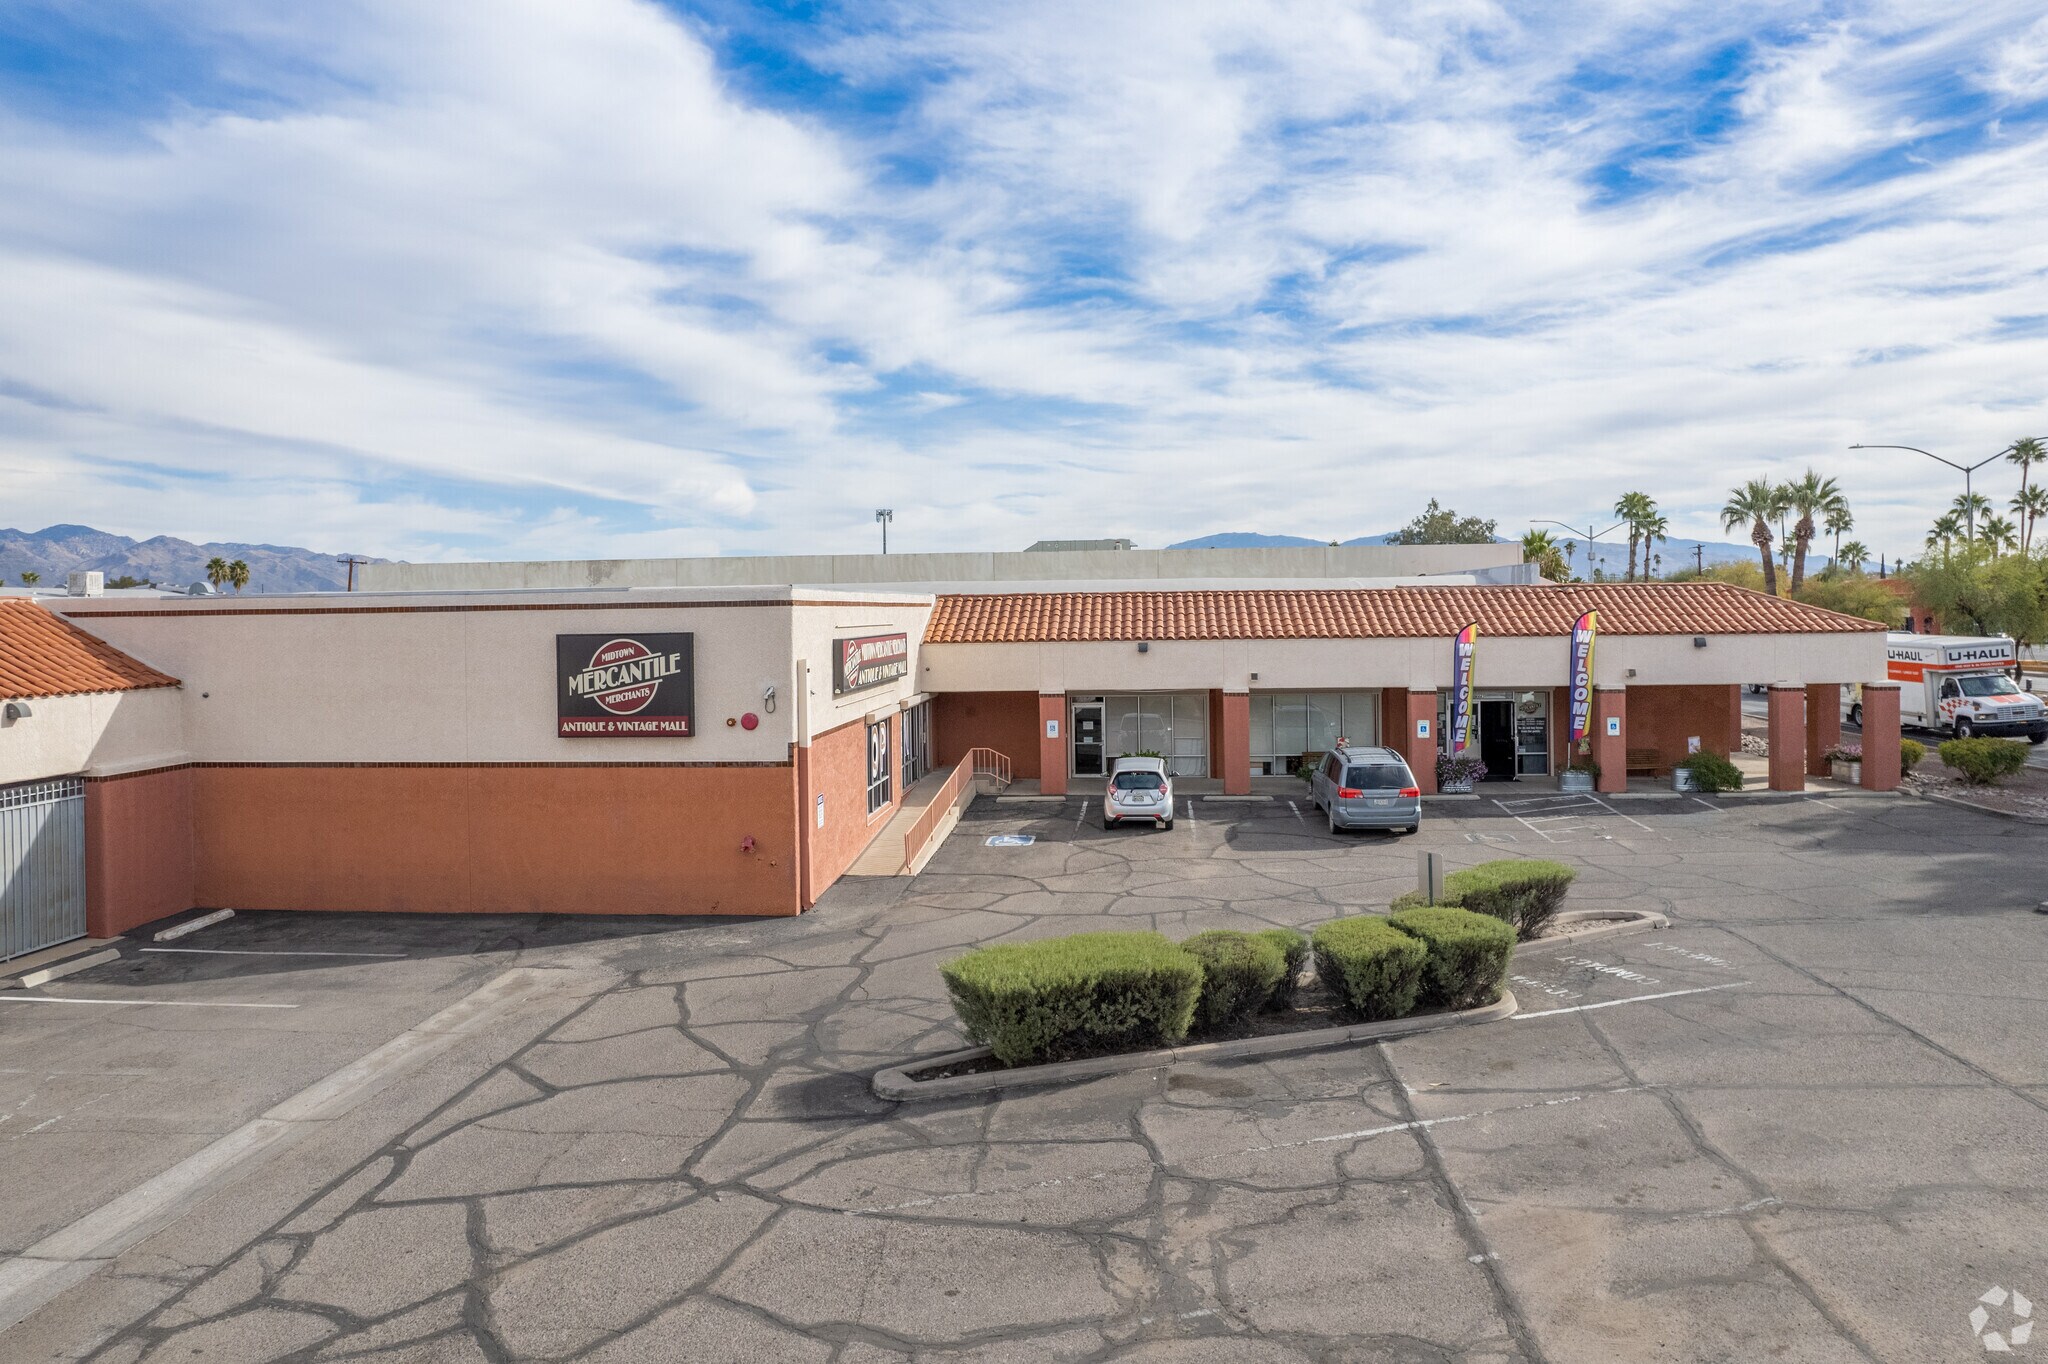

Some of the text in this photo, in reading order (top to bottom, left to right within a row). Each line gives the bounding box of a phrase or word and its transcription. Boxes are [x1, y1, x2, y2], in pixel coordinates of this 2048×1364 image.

[601, 647, 635, 662] MIDTOWN
[1948, 648, 2010, 661] U-HAUL
[568, 652, 681, 696] MERCANTILE
[1573, 629, 1593, 730] WELCOME
[605, 687, 651, 705] MERCHANTS
[1455, 643, 1474, 743] WELCOME
[562, 721, 688, 732] ANTIQUE & VINTAGE MALL
